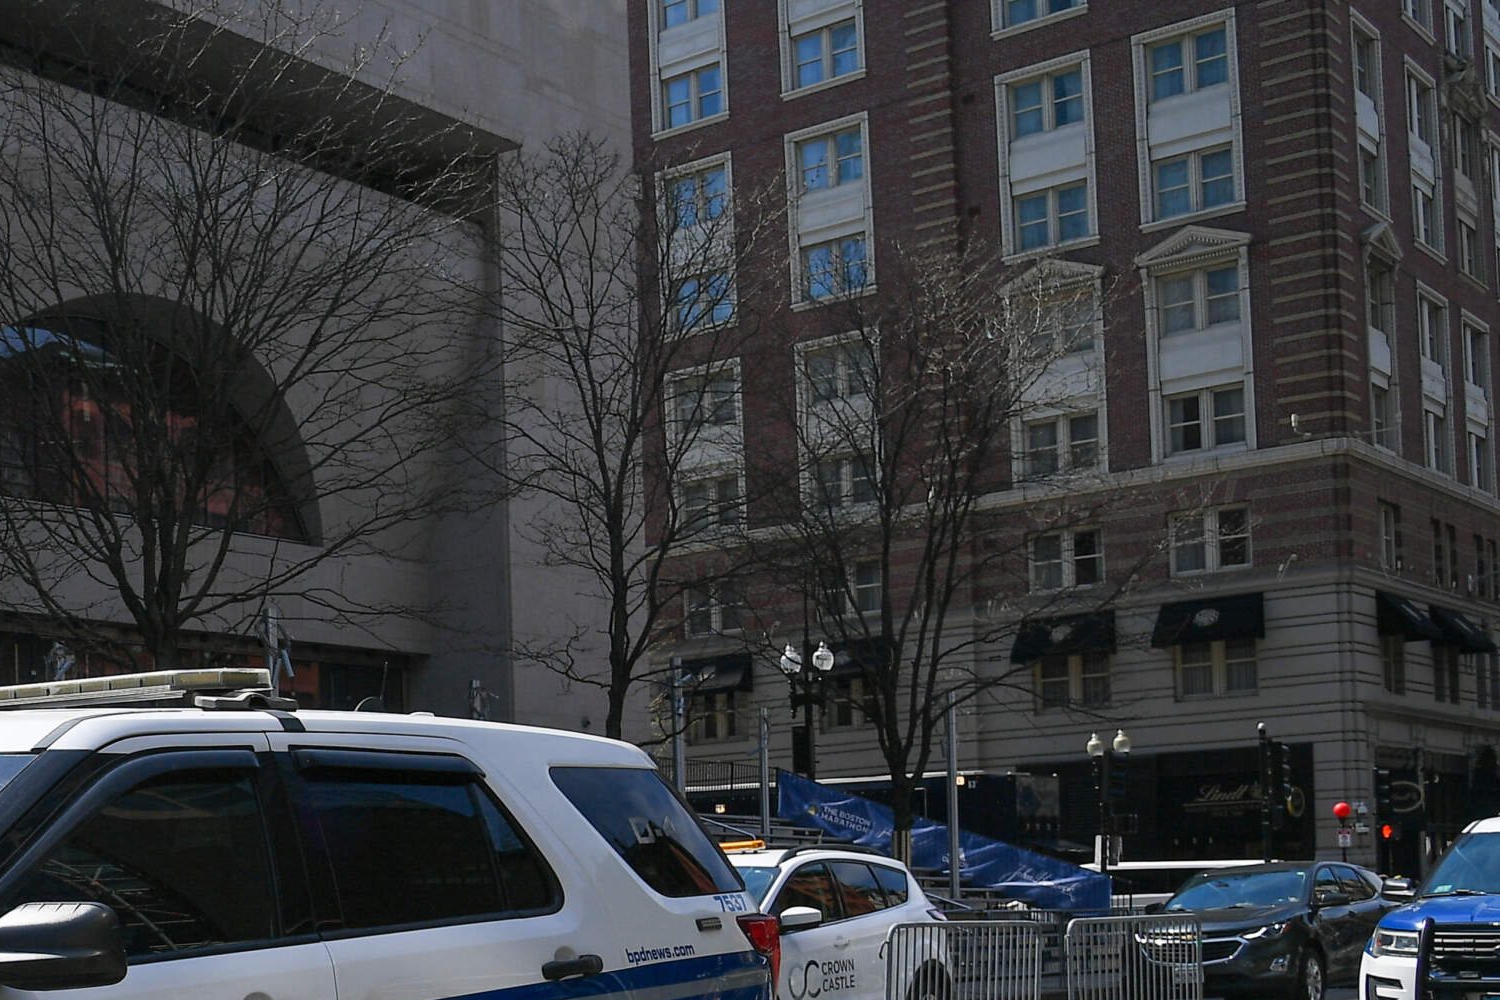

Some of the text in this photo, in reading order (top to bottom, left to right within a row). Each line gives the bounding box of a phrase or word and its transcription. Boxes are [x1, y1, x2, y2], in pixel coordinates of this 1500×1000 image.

[820, 813, 870, 833] MARATHON
[823, 806, 871, 827] THE BOSTON
[713, 893, 747, 912] 7537
[625, 944, 695, 965] bpdnews.com
[821, 959, 855, 976] CROWN
[822, 980, 856, 997] CASTLE
